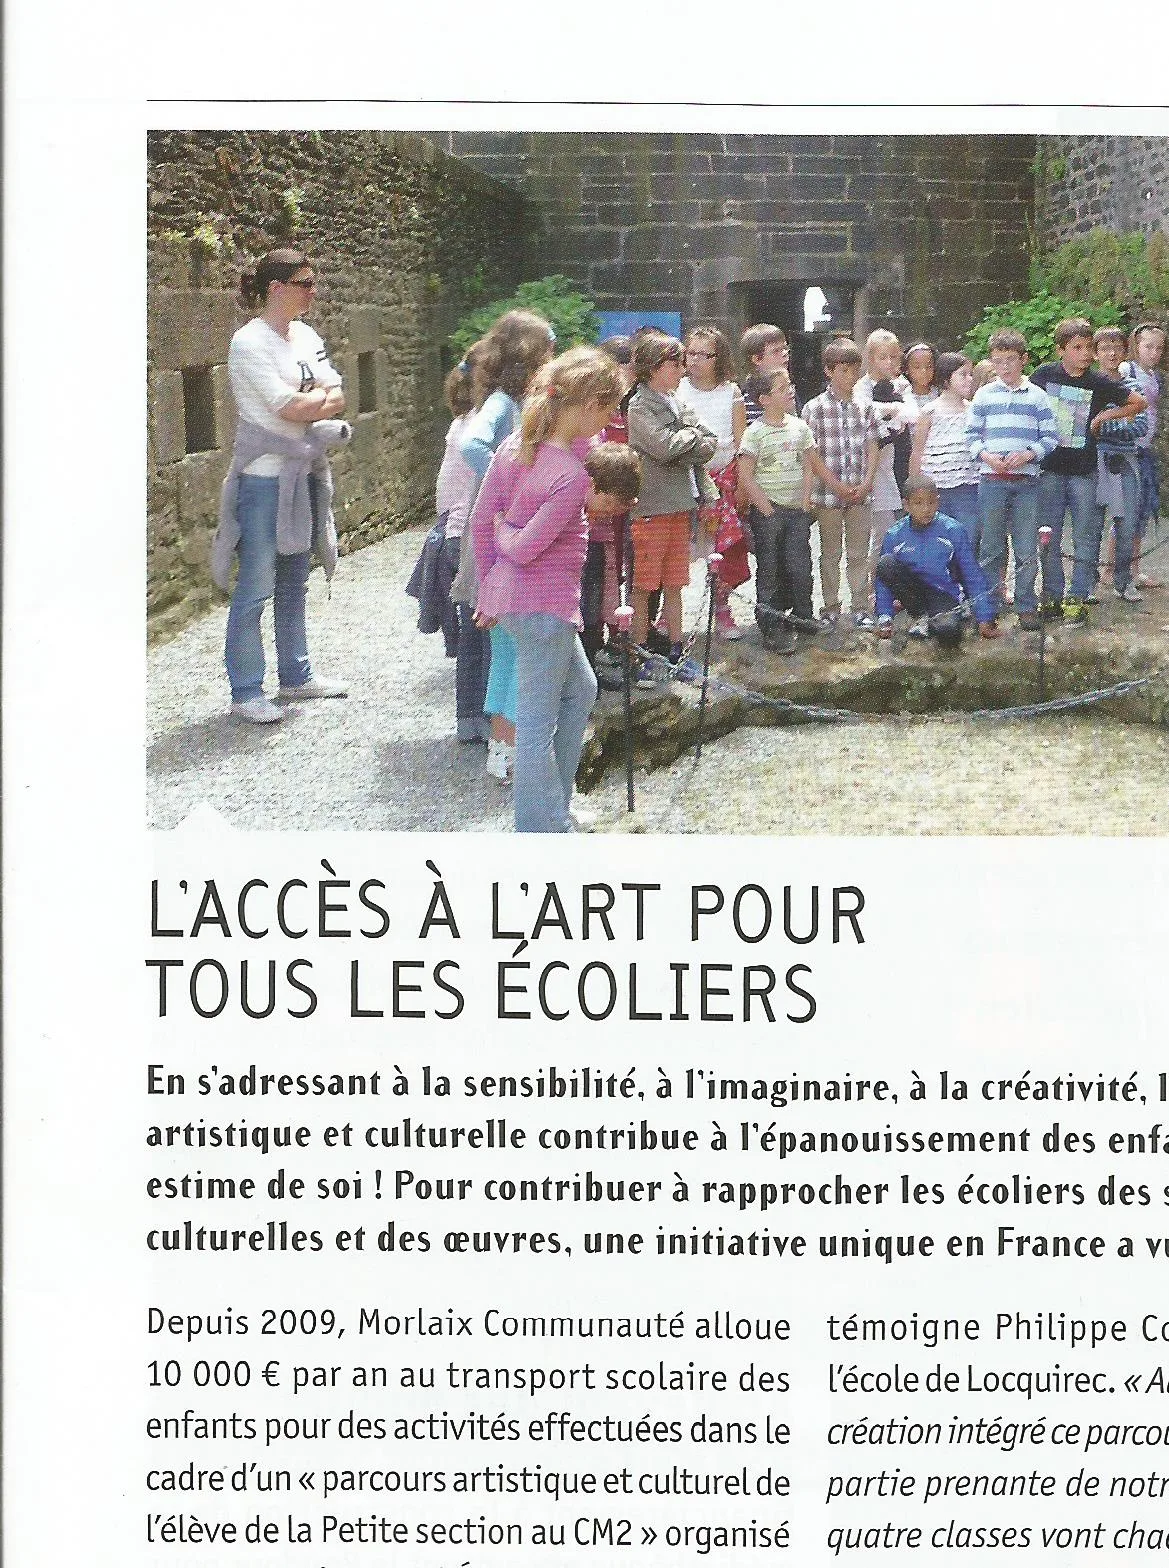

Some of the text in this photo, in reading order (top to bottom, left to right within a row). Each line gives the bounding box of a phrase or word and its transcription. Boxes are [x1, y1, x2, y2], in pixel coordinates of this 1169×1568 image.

[151, 858, 866, 945] L'ACCÈS À L'ART POUR
[144, 939, 817, 1024] TOUS LES ÉCOLIERS
[147, 1064, 185, 1096] En
[198, 1064, 381, 1096] s'adressant
[392, 1064, 409, 1097] à
[421, 1065, 451, 1097] la
[464, 1066, 645, 1102] sensibilité,
[655, 1066, 673, 1099] à
[685, 1068, 898, 1108] l'imaginaire,
[909, 1069, 927, 1101] à
[939, 1070, 968, 1101] la
[981, 1069, 1147, 1106] créativité,
[146, 1118, 312, 1155] artistique
[323, 1122, 354, 1147] et
[364, 1117, 527, 1149] culturelle
[538, 1119, 699, 1151] contribue
[710, 1120, 728, 1152] à
[740, 1121, 1031, 1160] l'épanouissement
[1042, 1122, 1096, 1154] des
[148, 1306, 791, 1343] Depuis 2009, Morlaix Communauté alloue
[826, 1312, 980, 1348] témoigne
[996, 1311, 1127, 1349] Philippe
[147, 1359, 790, 1397] 10 000 € par an au transport scolaire des
[827, 1522, 922, 1557] quatre
[931, 1519, 1033, 1549] classes
[1041, 1522, 1107, 1549] vont
